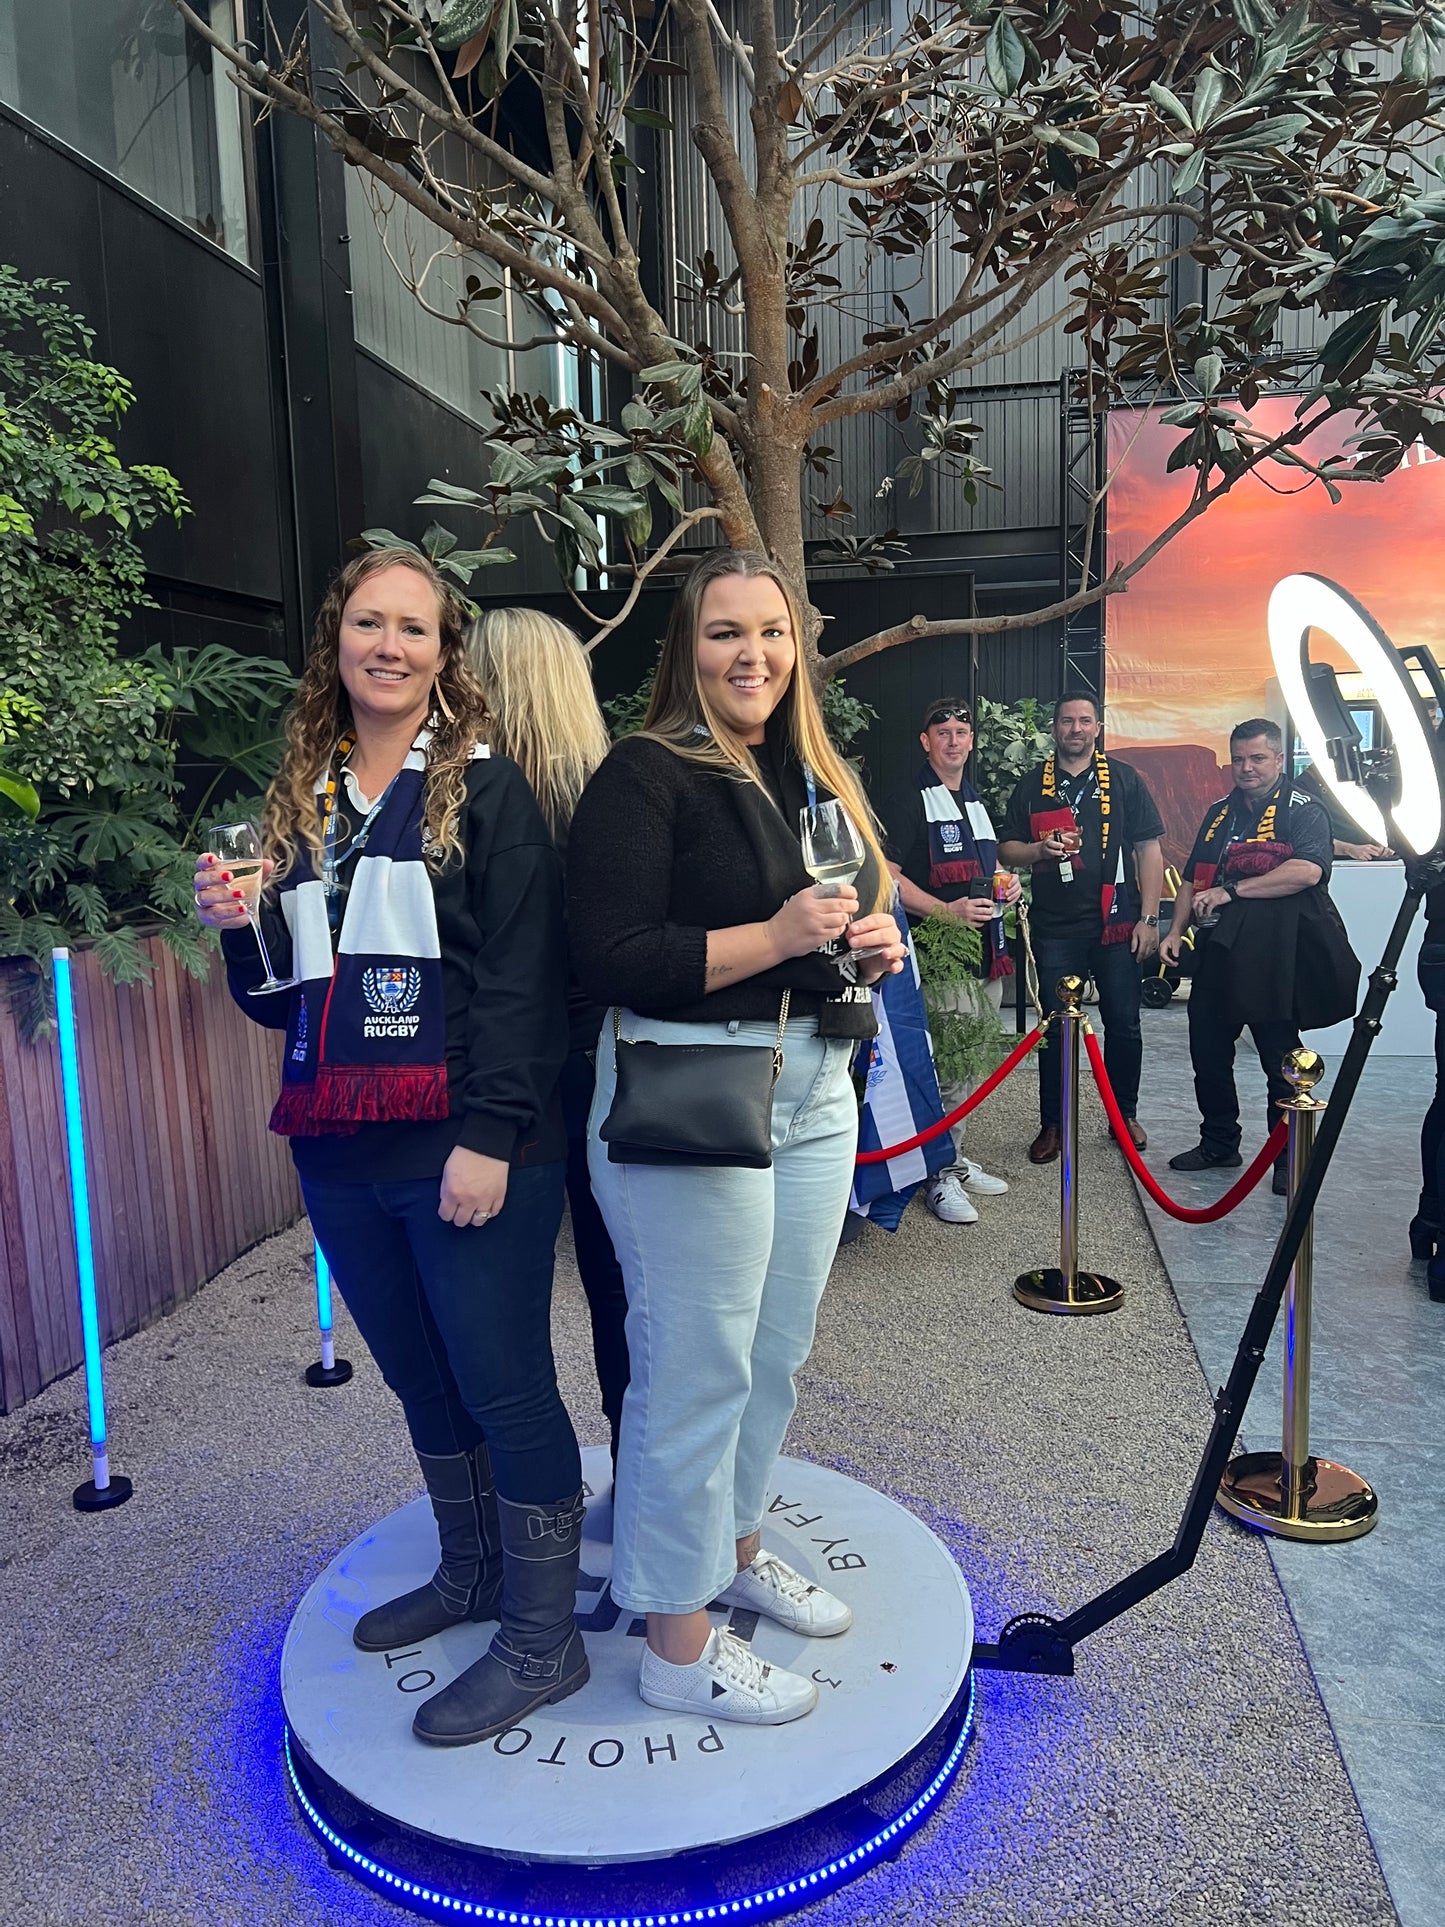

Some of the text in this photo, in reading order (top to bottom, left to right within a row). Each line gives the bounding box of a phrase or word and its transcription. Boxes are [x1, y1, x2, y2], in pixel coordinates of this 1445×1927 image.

[363, 1024, 419, 1037] RUGBY
[364, 1015, 420, 1025] AUCKLAND
[767, 1494, 867, 1572] BY FA
[811, 1668, 842, 1689] 3
[493, 1724, 726, 1768] PHOTO
